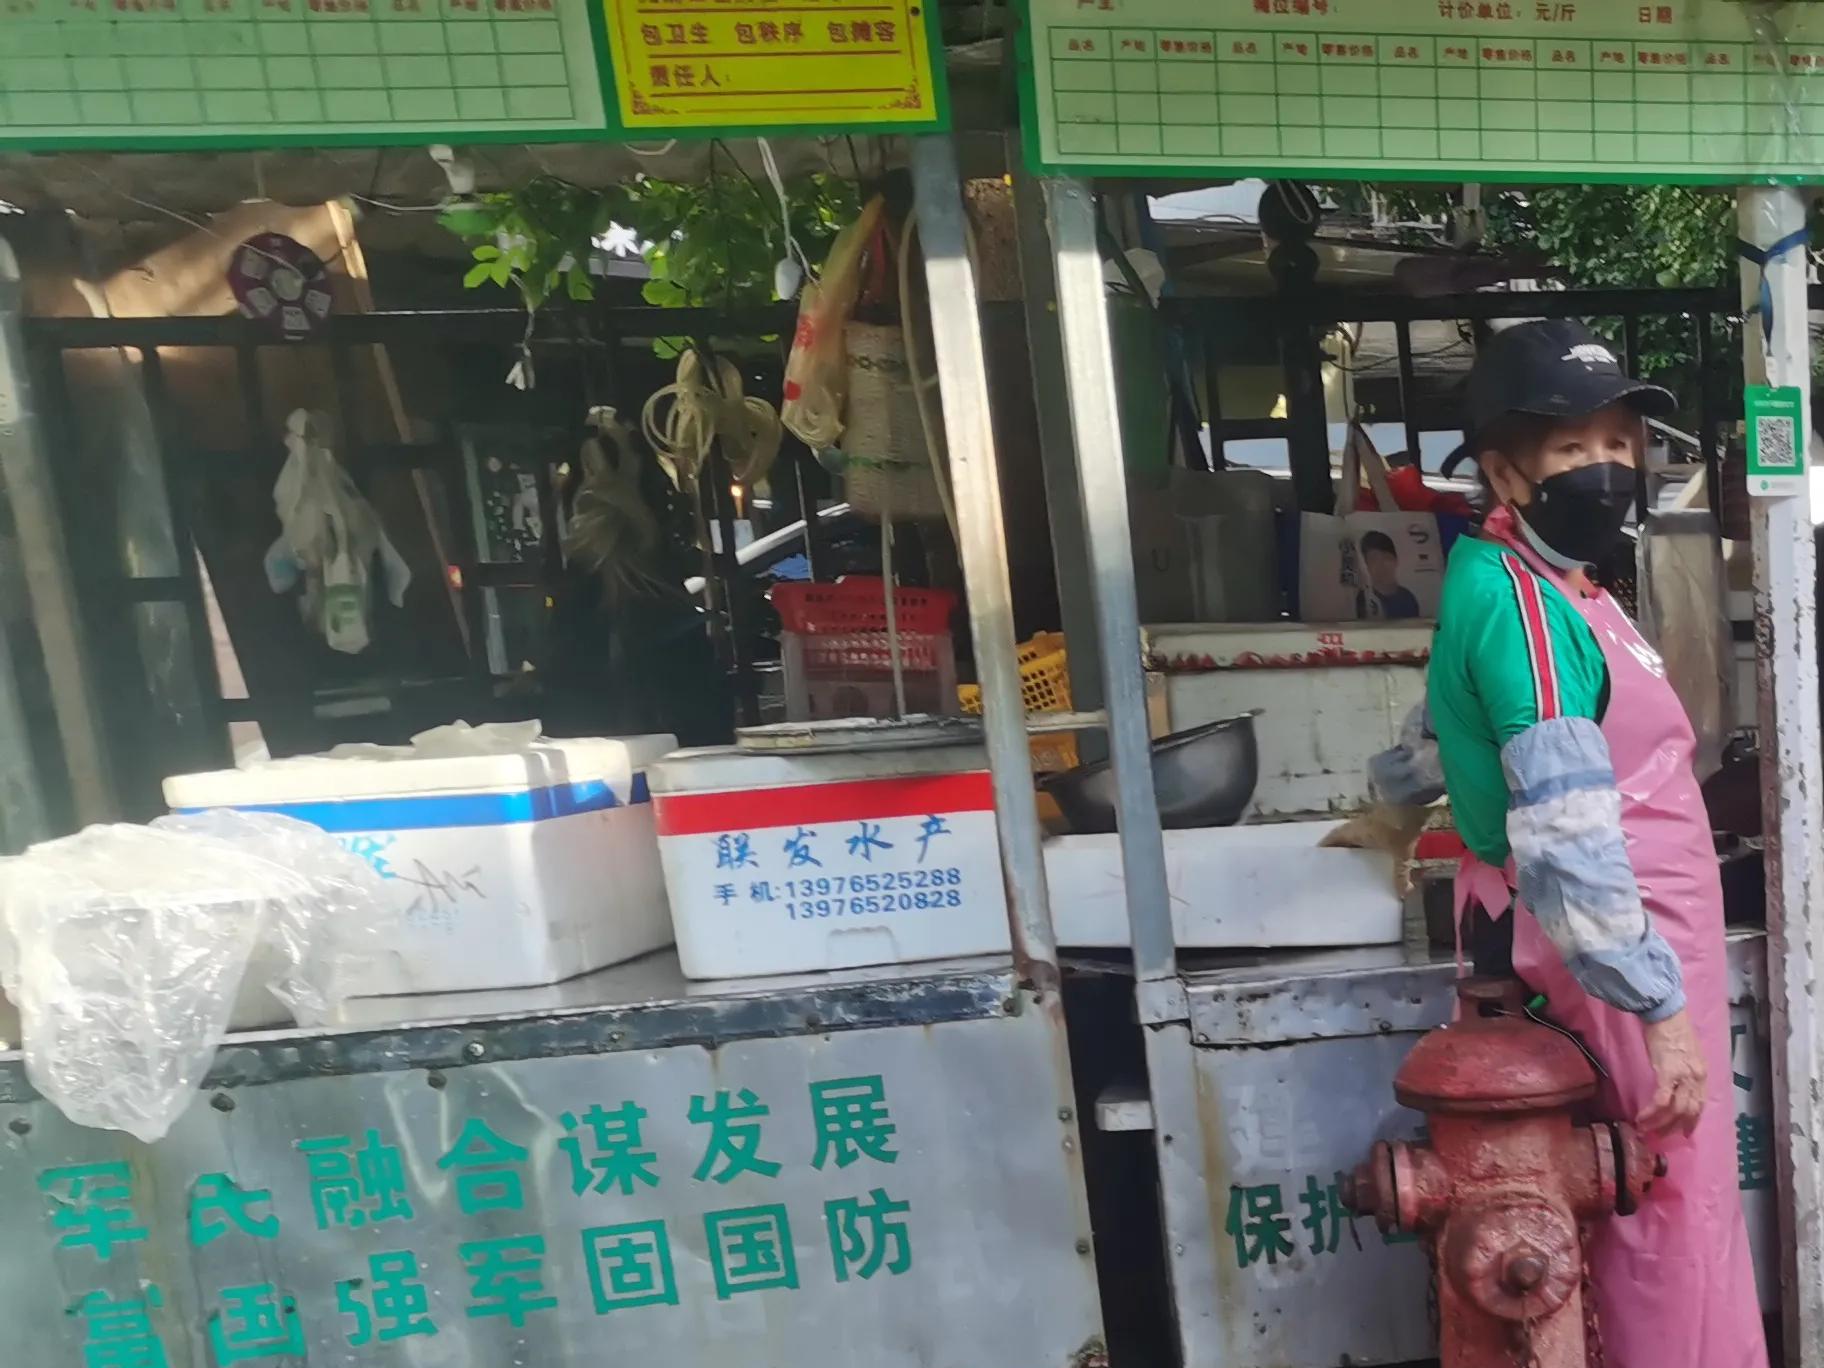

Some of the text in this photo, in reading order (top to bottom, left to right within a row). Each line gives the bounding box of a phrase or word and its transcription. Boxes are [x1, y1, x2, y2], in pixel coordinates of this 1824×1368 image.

[1536, 3, 1576, 21] 元/斤
[1639, 6, 1672, 23] 日期
[785, 889, 962, 920] 13976520828
[30, 1073, 901, 1264] 军民融合谋发展
